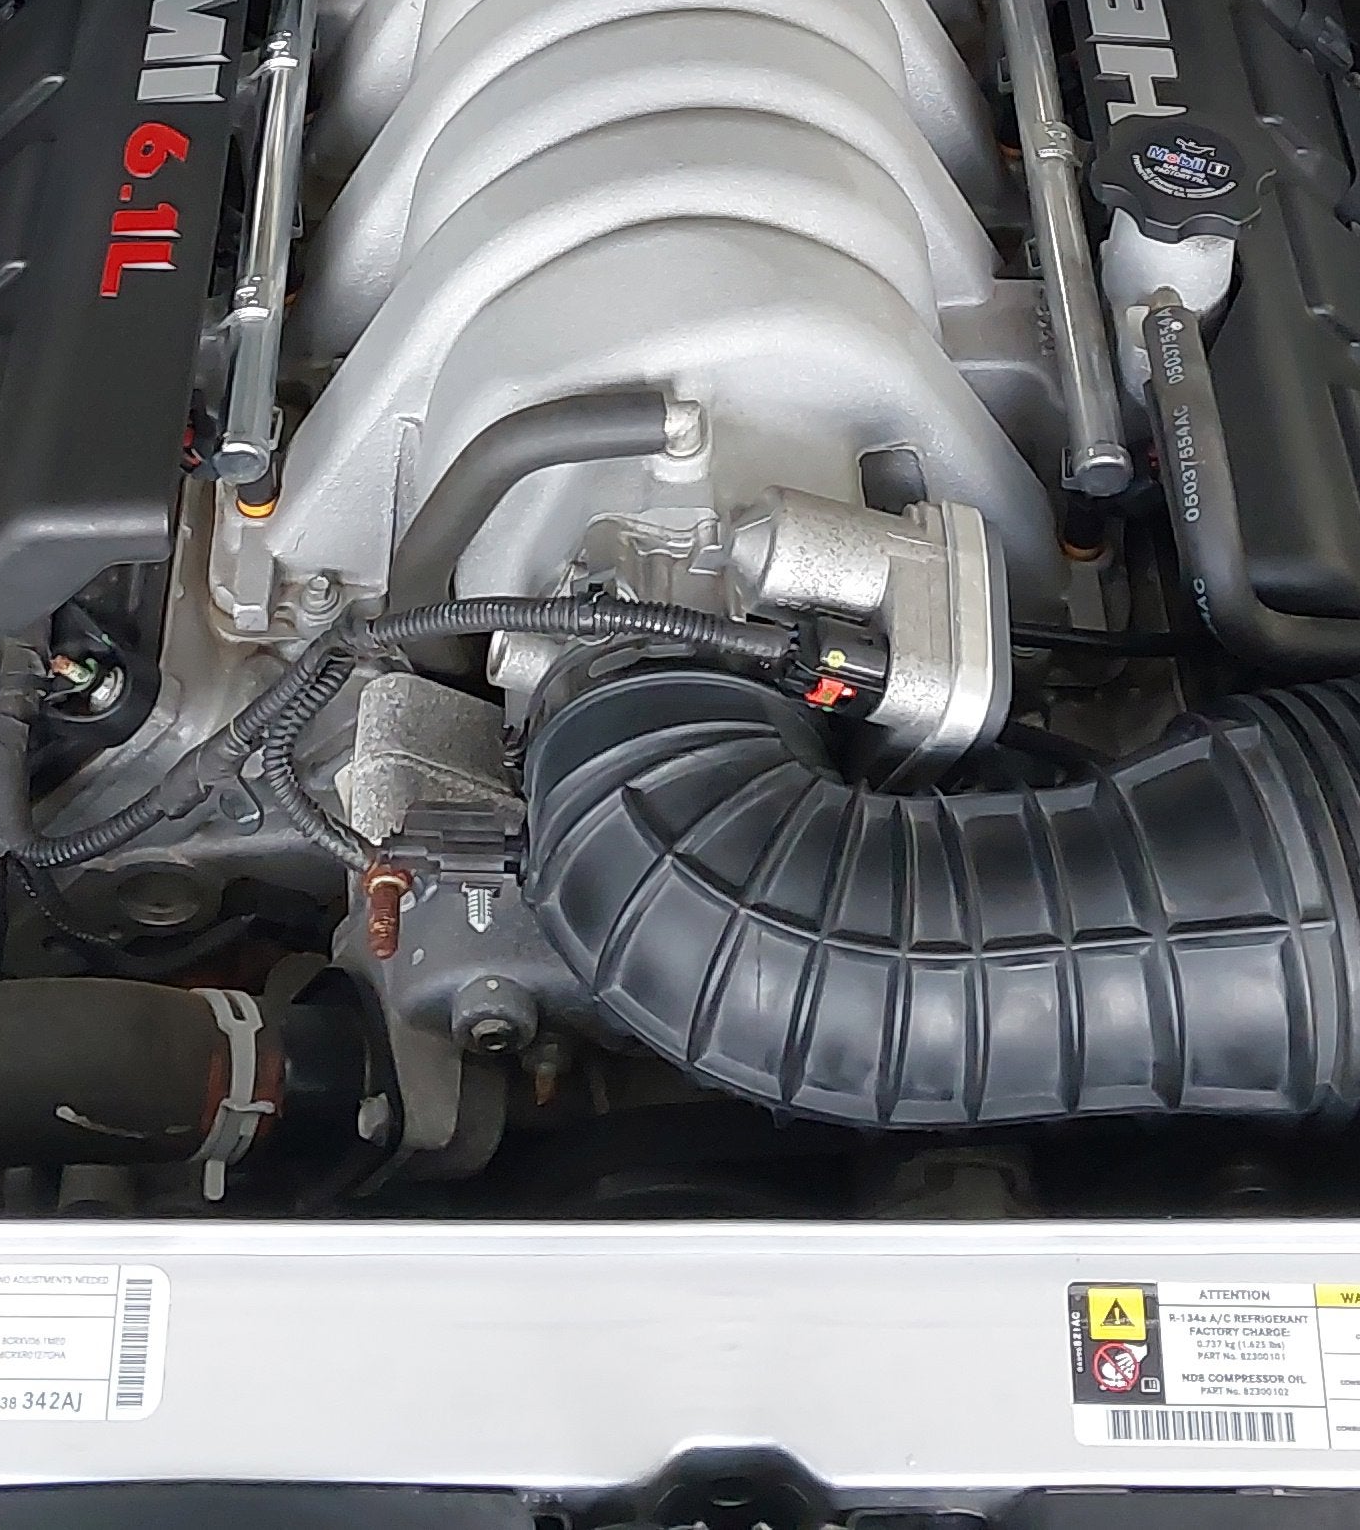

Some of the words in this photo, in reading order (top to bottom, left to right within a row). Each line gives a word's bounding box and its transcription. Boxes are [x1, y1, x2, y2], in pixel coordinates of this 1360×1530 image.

[1146, 144, 1207, 172] Mobil
[99, 121, 189, 297] 6.1L
[1173, 405, 1201, 522] 05037554AC
[1199, 1290, 1271, 1300] ATTENTION
[1209, 1314, 1232, 1325] A/C
[1234, 1315, 1309, 1324] REFRIGERANT
[1189, 1327, 1240, 1336] FACTORY
[1197, 1352, 1221, 1360] PART
[1208, 1374, 1285, 1383] COMPRESSOR
[1288, 1375, 1307, 1384] OIL
[1200, 1387, 1225, 1395] PART
[22, 1391, 83, 1412] 342AJ
